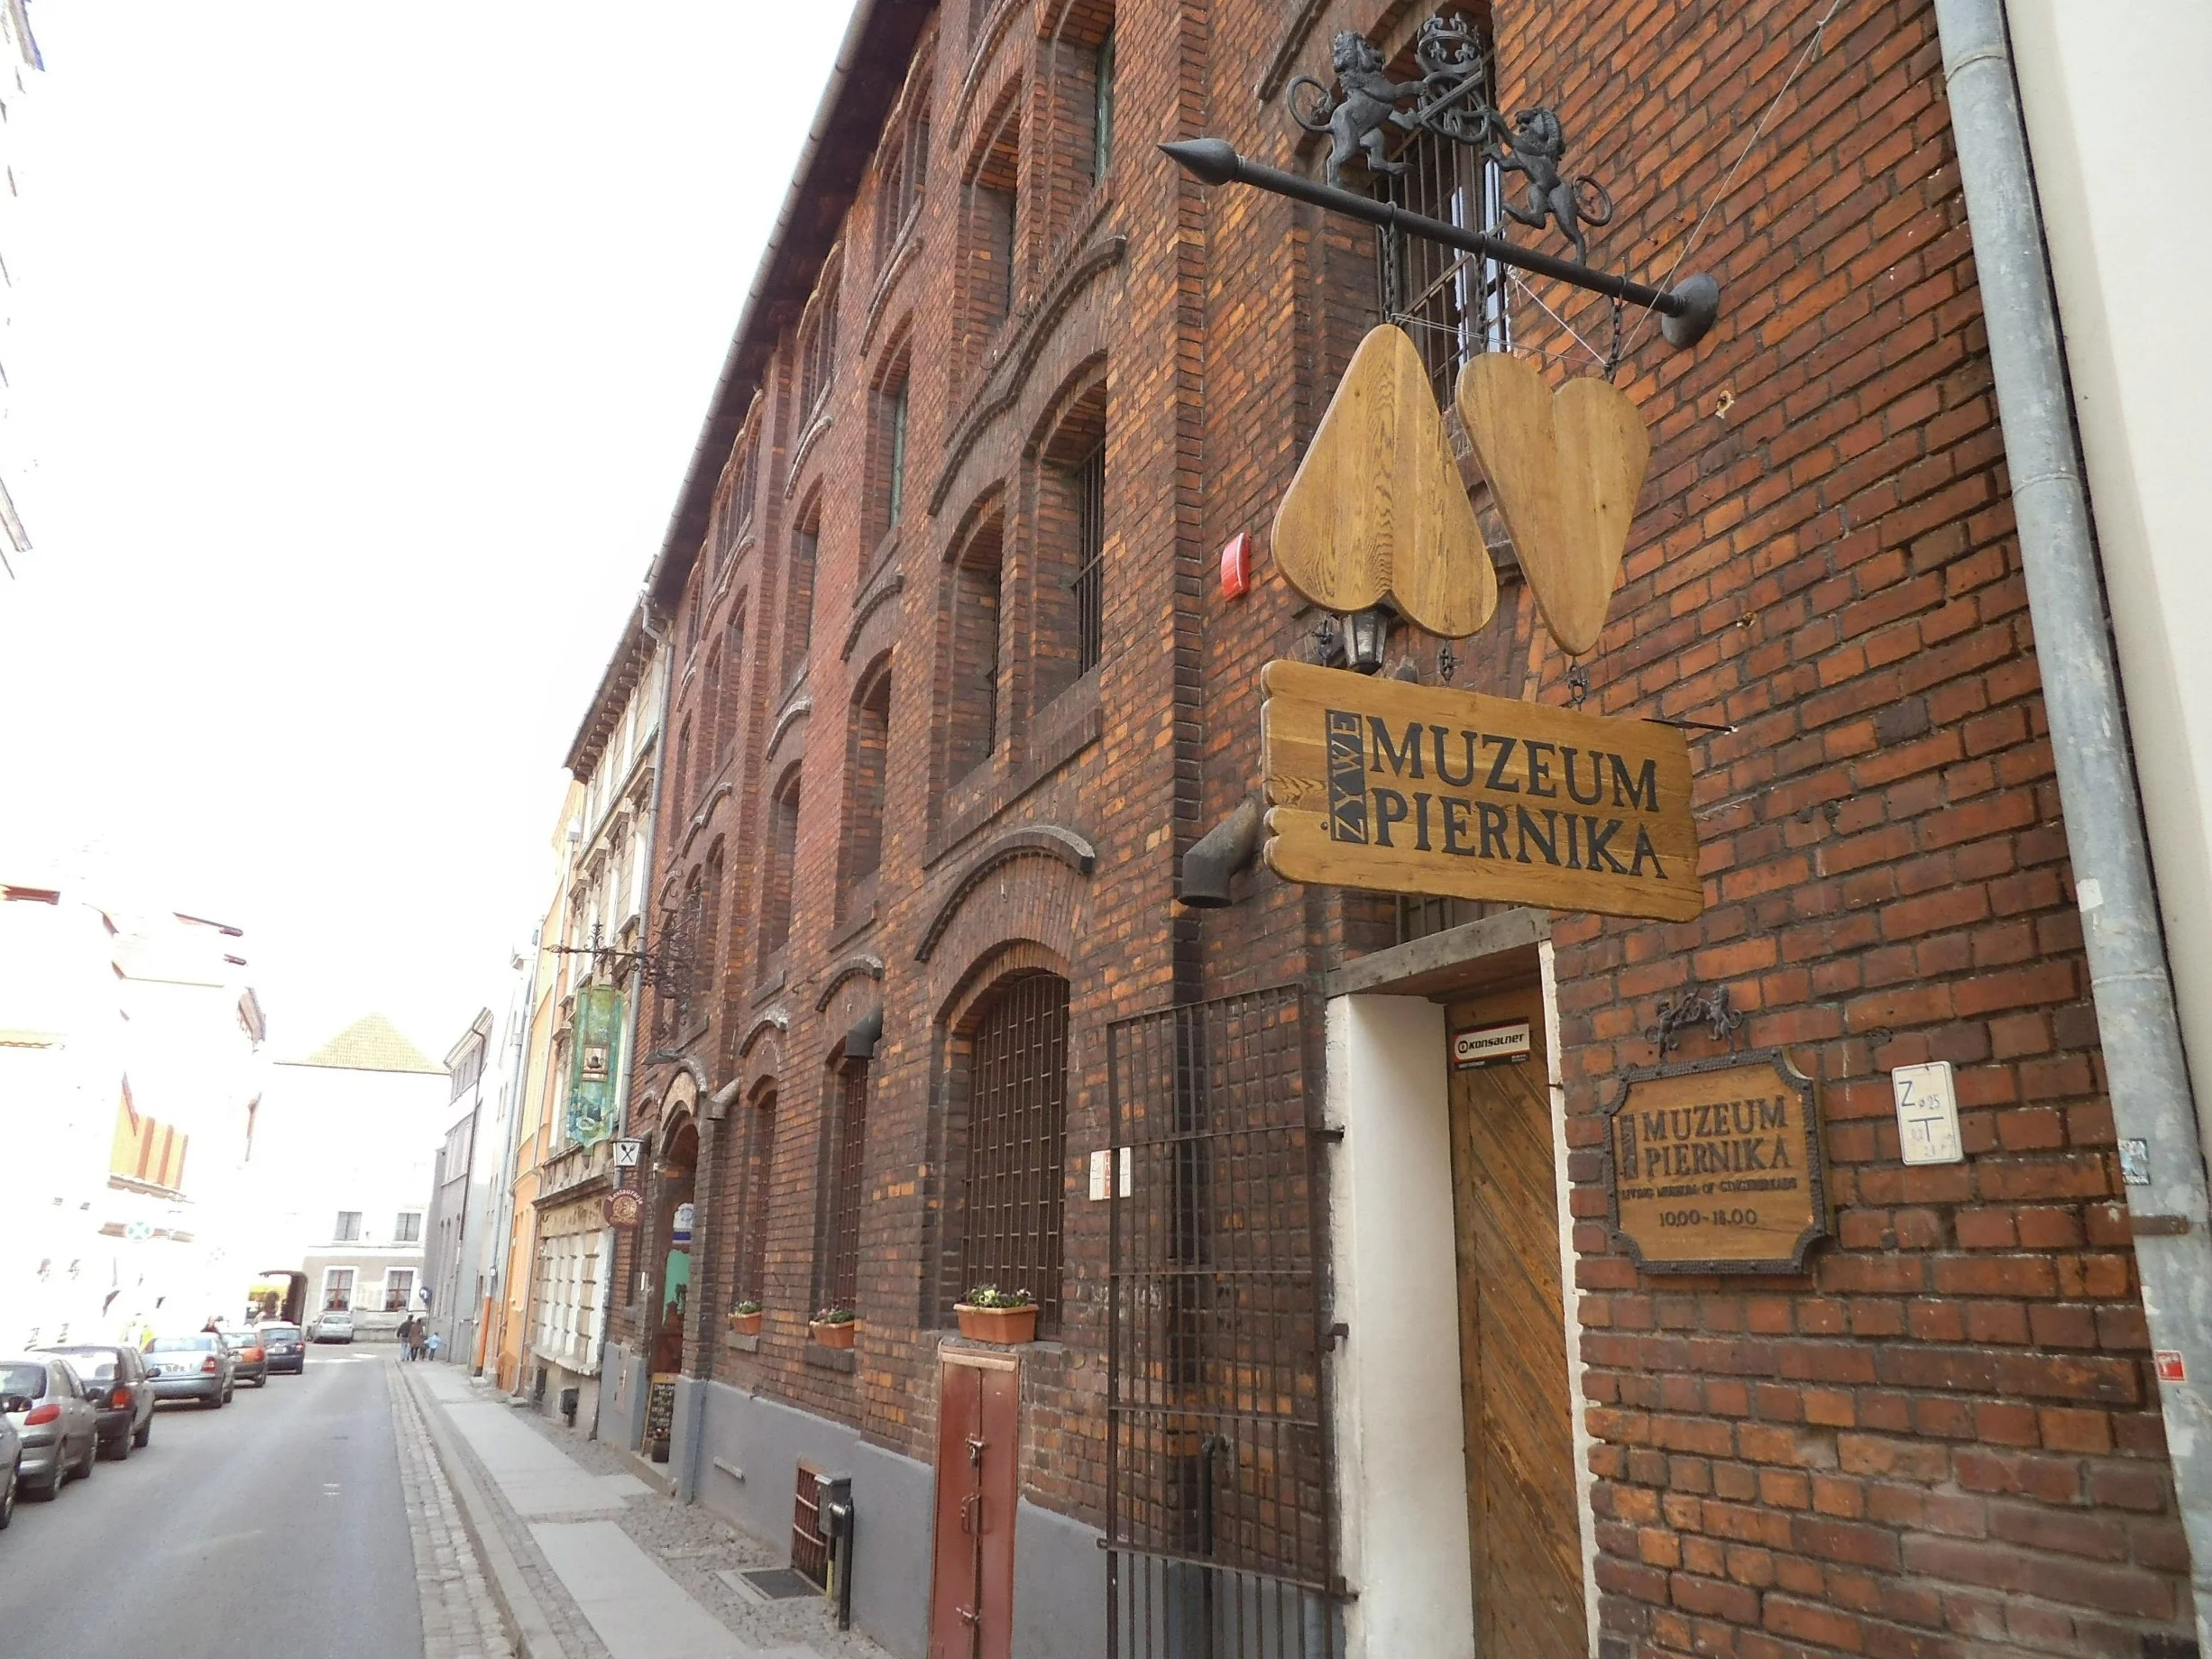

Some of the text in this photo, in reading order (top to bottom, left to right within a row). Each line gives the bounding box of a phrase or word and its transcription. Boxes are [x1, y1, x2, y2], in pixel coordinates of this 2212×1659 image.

[1365, 715, 1659, 812] MUZEUM
[1370, 787, 1668, 880] PIERNIKA
[1642, 1095, 1789, 1141] MUZEUM
[1645, 1134, 1793, 1177] PIERNIKA
[1622, 1187, 1655, 1200] LIVING
[1702, 1181, 1715, 1195] OF
